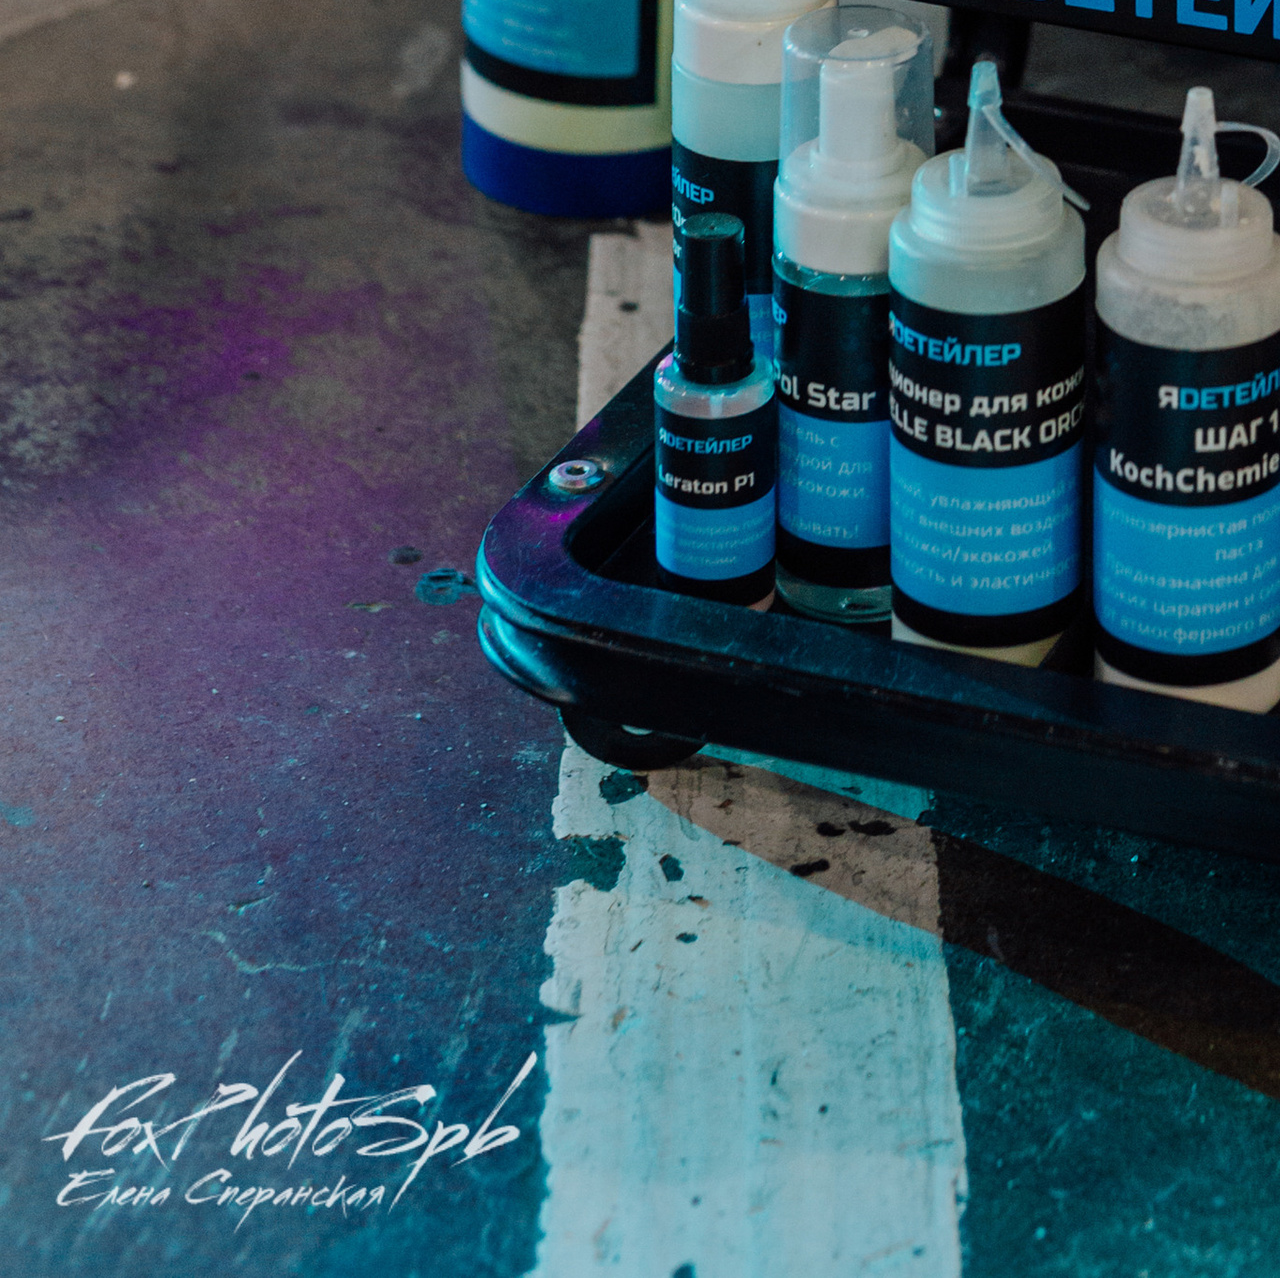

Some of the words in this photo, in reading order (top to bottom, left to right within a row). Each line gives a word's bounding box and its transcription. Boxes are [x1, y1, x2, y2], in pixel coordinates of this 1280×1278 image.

[807, 381, 877, 411] Star
[969, 391, 1028, 418] для
[935, 425, 1032, 452] BLACK
[1194, 415, 1263, 453] ШАГ
[1269, 408, 1279, 433] 1
[659, 464, 729, 495] Leraton
[734, 471, 755, 492] P1
[1109, 448, 1280, 493] KochChemie
[1215, 538, 1264, 562] паста
